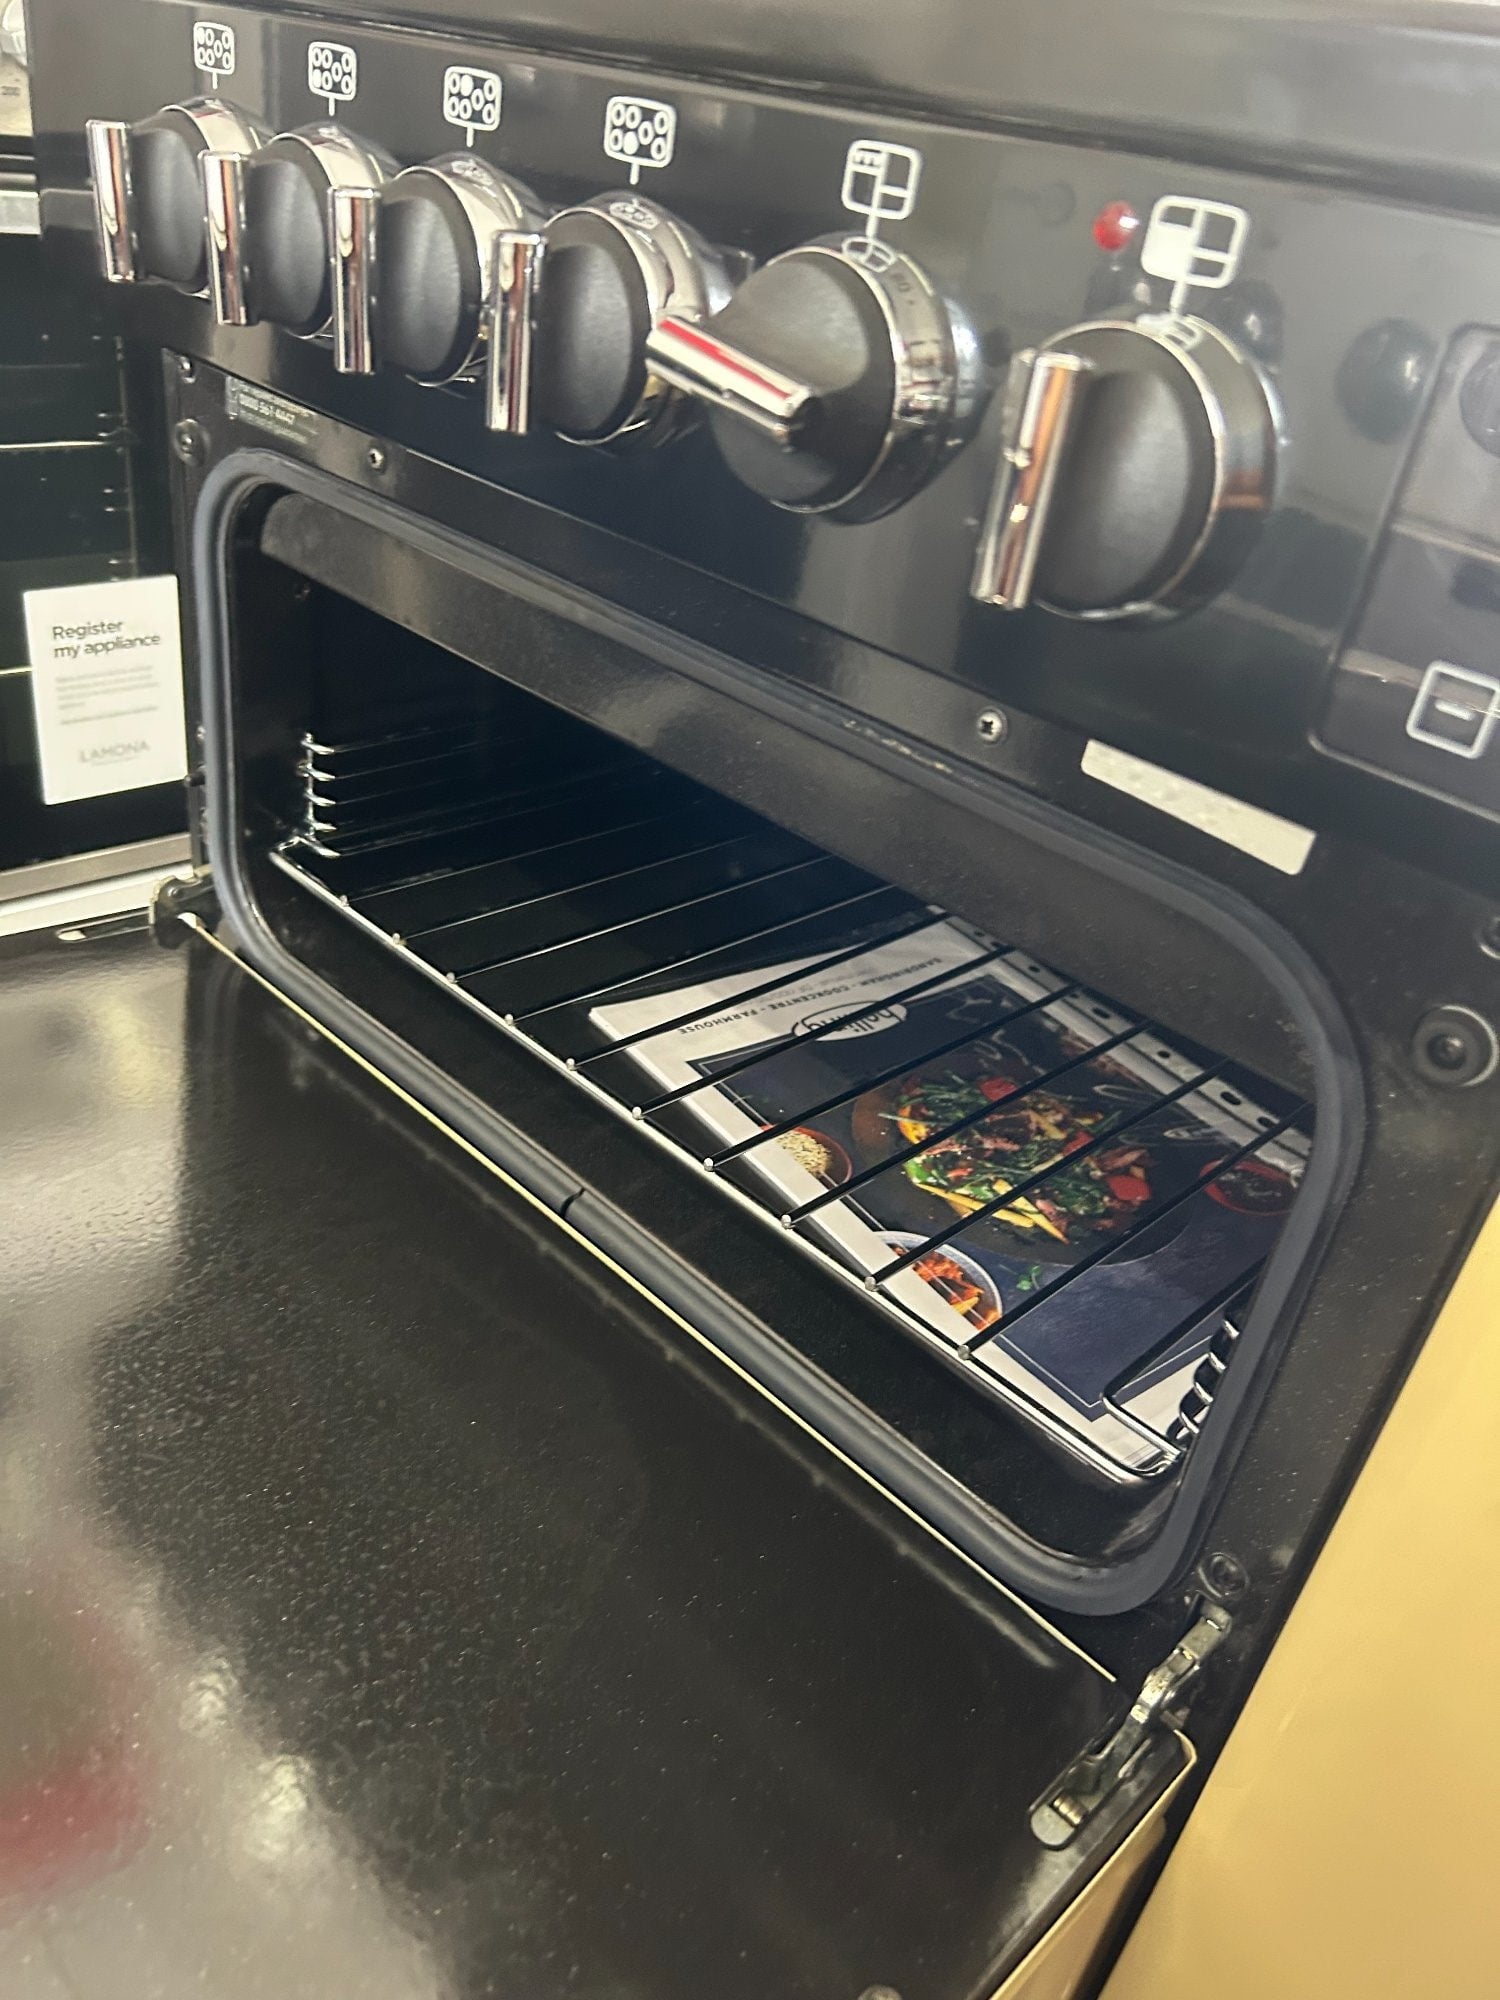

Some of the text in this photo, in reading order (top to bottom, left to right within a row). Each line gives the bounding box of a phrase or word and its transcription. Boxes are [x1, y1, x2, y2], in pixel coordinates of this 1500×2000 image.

[52, 621, 122, 641] Register
[54, 634, 161, 659] my appliance
[81, 741, 149, 762] LAMONA
[769, 985, 851, 1011] COOKCENTRE
[678, 1009, 758, 1034] FARMHOUSE
